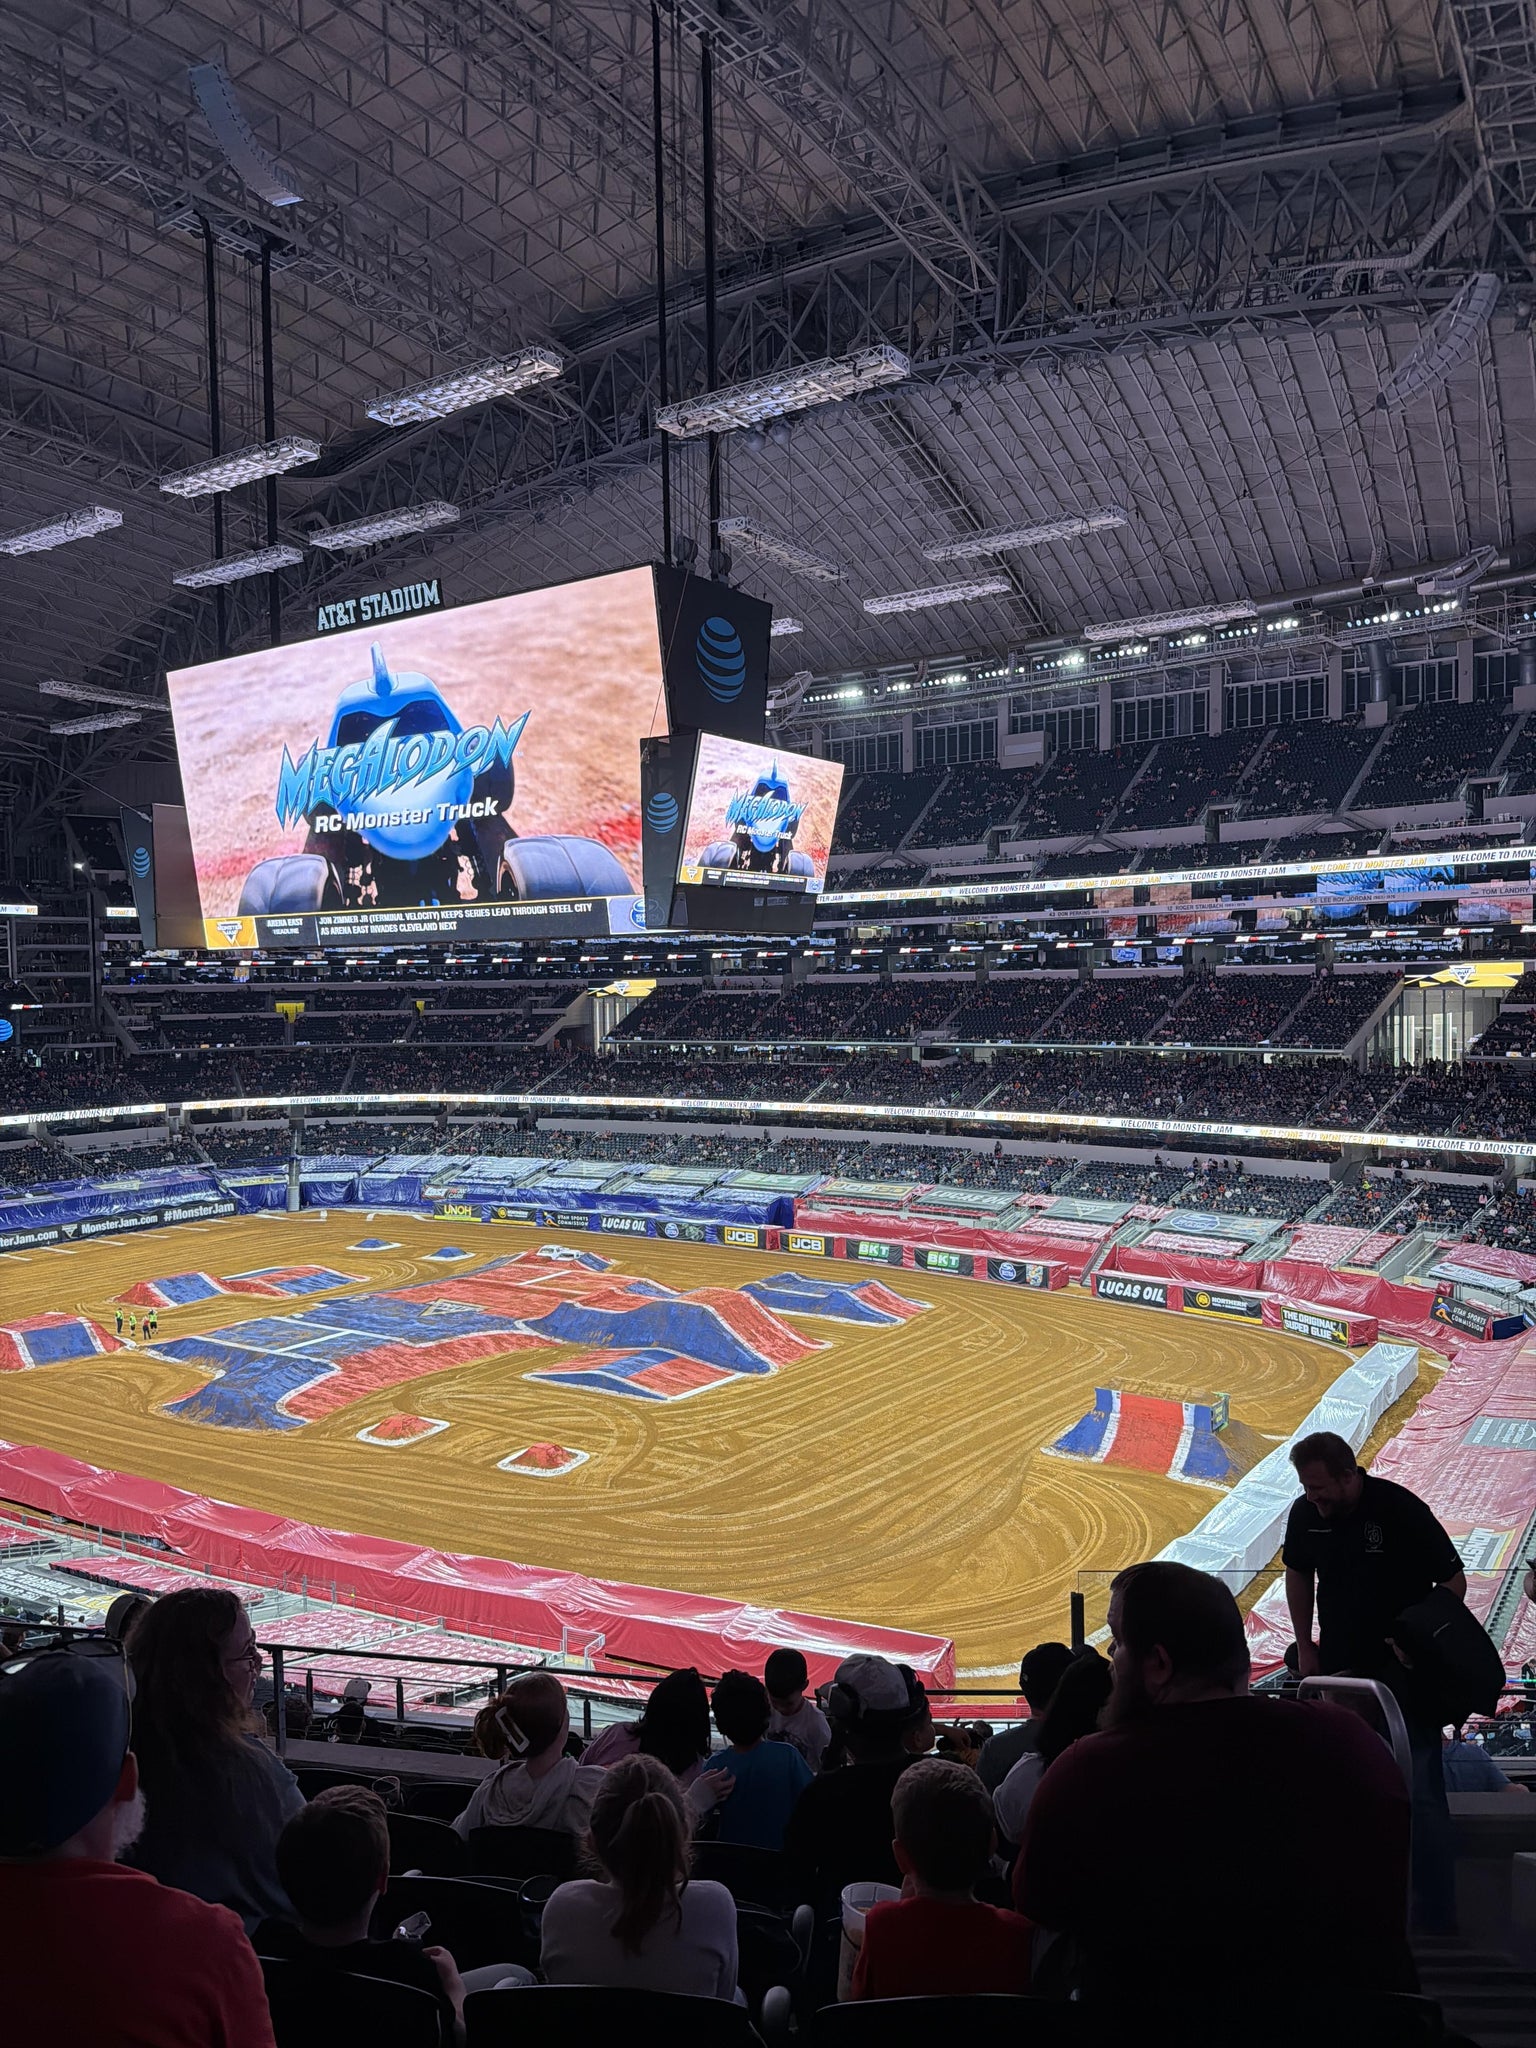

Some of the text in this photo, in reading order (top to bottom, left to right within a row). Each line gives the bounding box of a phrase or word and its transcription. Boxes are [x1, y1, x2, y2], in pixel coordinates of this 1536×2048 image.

[317, 579, 440, 631] AT&T STADIUM
[276, 709, 532, 832] MEGALODON
[314, 797, 499, 834] RC Monster Truck
[1453, 852, 1496, 862] WELCOME
[1310, 863, 1350, 872] WELCOME
[1365, 859, 1405, 868] MONSTER
[1408, 858, 1427, 866] JAM
[1182, 872, 1218, 880] WELCOME
[1230, 868, 1267, 877] MONSTER
[333, 916, 358, 924] ZIMMER
[406, 911, 440, 921] VELOCITY)
[441, 910, 464, 919] KEEPS
[465, 908, 490, 918] SERIES
[492, 908, 510, 917] LEAD
[512, 906, 548, 916] THROUGH
[549, 904, 573, 914] STEEL
[575, 903, 592, 913] CITY
[288, 918, 303, 926] EAST
[354, 925, 369, 934] EAST
[370, 924, 397, 933] INVADES
[399, 922, 438, 932] CLEVELAND
[439, 921, 457, 930] NEXT
[79, 1108, 114, 1118] MONSTER
[117, 1106, 131, 1115] JAM
[927, 1109, 959, 1117] MONSTER
[1121, 1120, 1232, 1134] WELCOME TO MONSTER JAM
[1417, 1139, 1533, 1155] WELCOME TO MONSTER
[164, 1202, 234, 1221] #MonsterJam
[444, 1204, 472, 1216] UNOH
[82, 1214, 158, 1234] MonsterJam.com
[602, 1218, 646, 1232] LUCAS OIL
[728, 1231, 755, 1242] JCB
[792, 1238, 822, 1251] JCB
[859, 1242, 889, 1258] BKT
[928, 1252, 958, 1268] BKT
[1099, 1280, 1166, 1303] LUCAS OIL
[1212, 1297, 1248, 1307] NORTHERN
[1283, 1310, 1336, 1329] THE ORIGINAL
[1452, 1314, 1484, 1332] COMMISSION
[1468, 1312, 1486, 1325] SPORTS
[1284, 1320, 1332, 1340] SUPER GLUE
